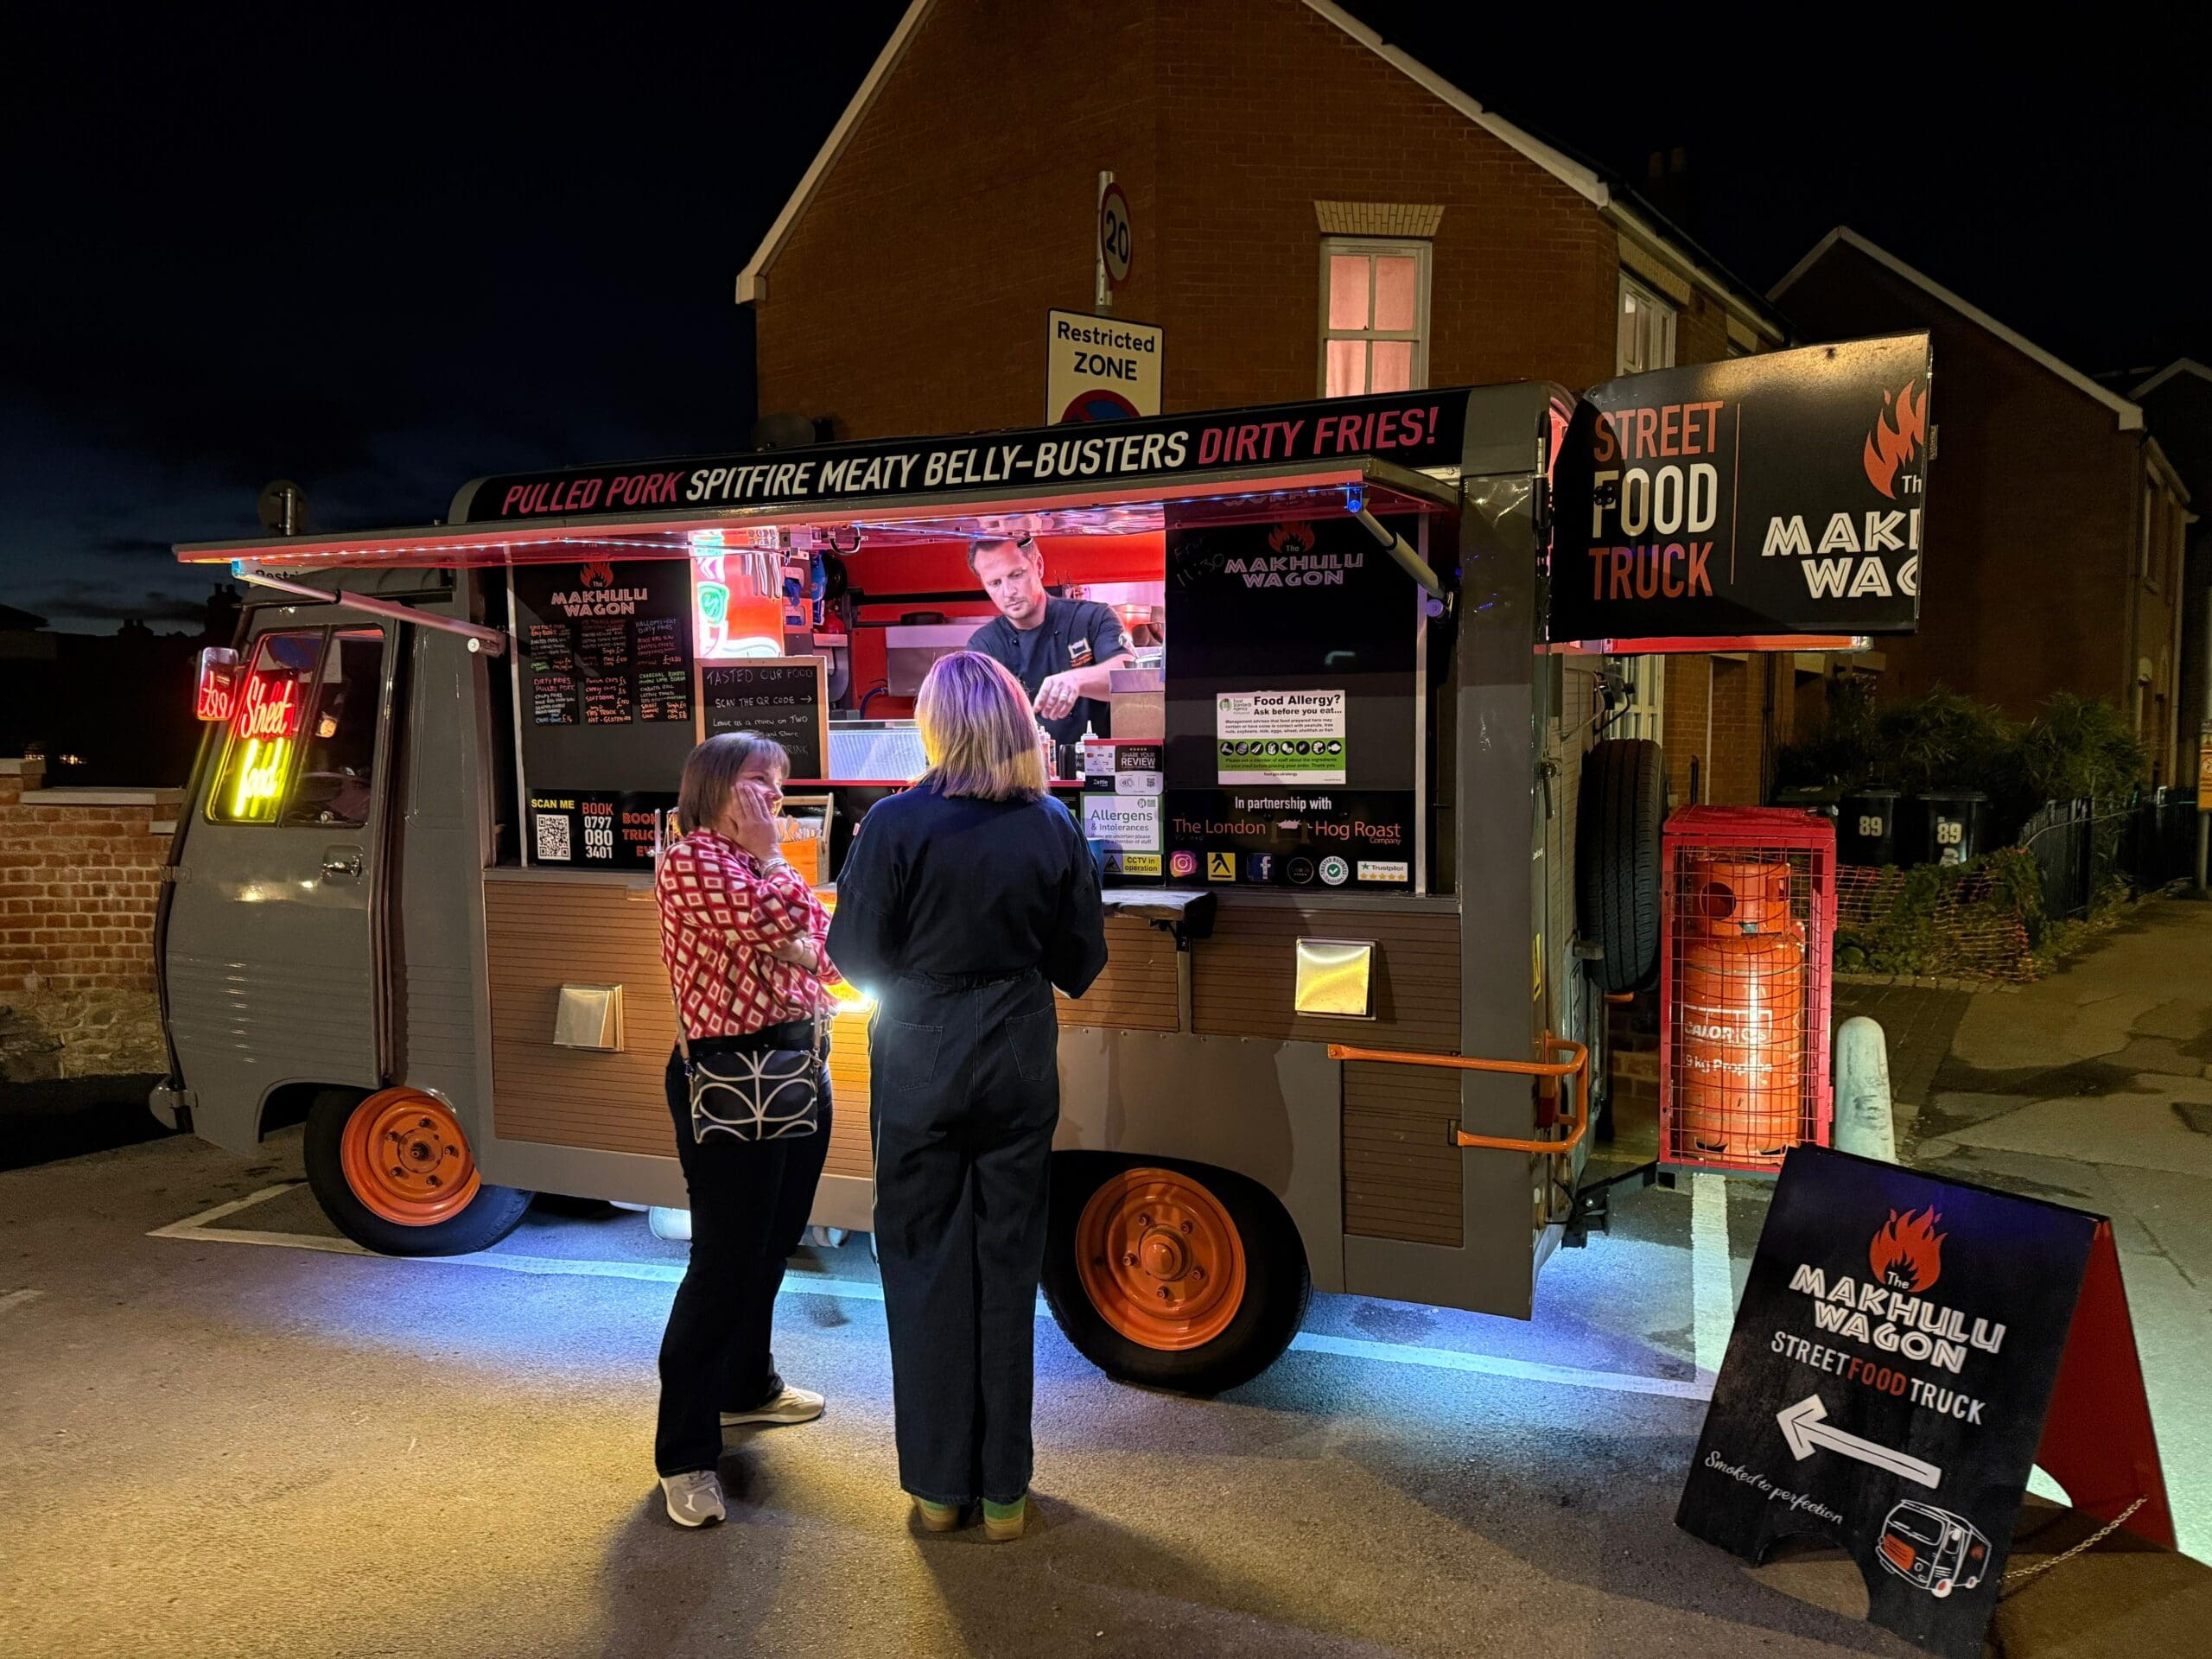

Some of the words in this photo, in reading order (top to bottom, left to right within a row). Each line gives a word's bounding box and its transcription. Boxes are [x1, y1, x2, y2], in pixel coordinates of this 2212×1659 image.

[1106, 210, 1129, 264] 20
[1058, 321, 1155, 353] Restricted
[1074, 351, 1138, 381] ZONE
[1593, 400, 1724, 462] STREET
[502, 480, 602, 515] PULLED
[605, 472, 685, 506] PORK
[686, 462, 815, 501] SPITFIRE
[818, 454, 920, 493] MEATY
[924, 431, 1189, 486] BELLY-BUSTERS
[1198, 420, 1306, 465] DIRTY
[1313, 407, 1440, 455] FRIES!
[1592, 462, 1718, 538] FOOD
[1224, 553, 1363, 574] MAKHULU
[1589, 542, 1714, 601] TRUCK
[1243, 569, 1344, 588] WAGON
[551, 588, 648, 605] MAKHULU
[563, 602, 635, 616] WAGON
[707, 668, 753, 686] TASTED
[760, 669, 783, 681] OUR
[787, 668, 814, 678] FOOD
[241, 676, 294, 738] Street
[715, 697, 735, 709] SCAN
[739, 697, 753, 708] THE
[756, 696, 770, 706] QR
[1254, 696, 1283, 706] Food
[1287, 694, 1341, 706] Allergy?
[790, 715, 809, 723] TWO
[1302, 708, 1318, 716] you
[531, 799, 557, 809] SCAN
[560, 800, 575, 810] ME
[582, 803, 614, 816] BOOK
[1235, 797, 1245, 809] In
[1247, 797, 1306, 812] partnership
[1309, 797, 1332, 810] with
[584, 816, 612, 829] 0797
[1090, 810, 1153, 823] Allergens
[1173, 819, 1201, 834] The
[1205, 819, 1266, 835] London
[1315, 821, 1350, 840] Hog
[1354, 821, 1402, 837] Roast
[1859, 816, 1883, 837] 89
[1936, 823, 1962, 844] 89
[584, 829, 613, 846] 080
[1370, 836, 1402, 845] Company
[585, 845, 613, 859] 3401
[1886, 1271, 1910, 1290] The
[1789, 1263, 2006, 1354] MAKHULU
[1814, 1300, 1967, 1374] WAGON
[1910, 1378, 1986, 1425] TRUCK
[1704, 1451, 1764, 1485] Smoked
[1758, 1473, 1772, 1491] to
[1768, 1487, 1844, 1525] perfection
